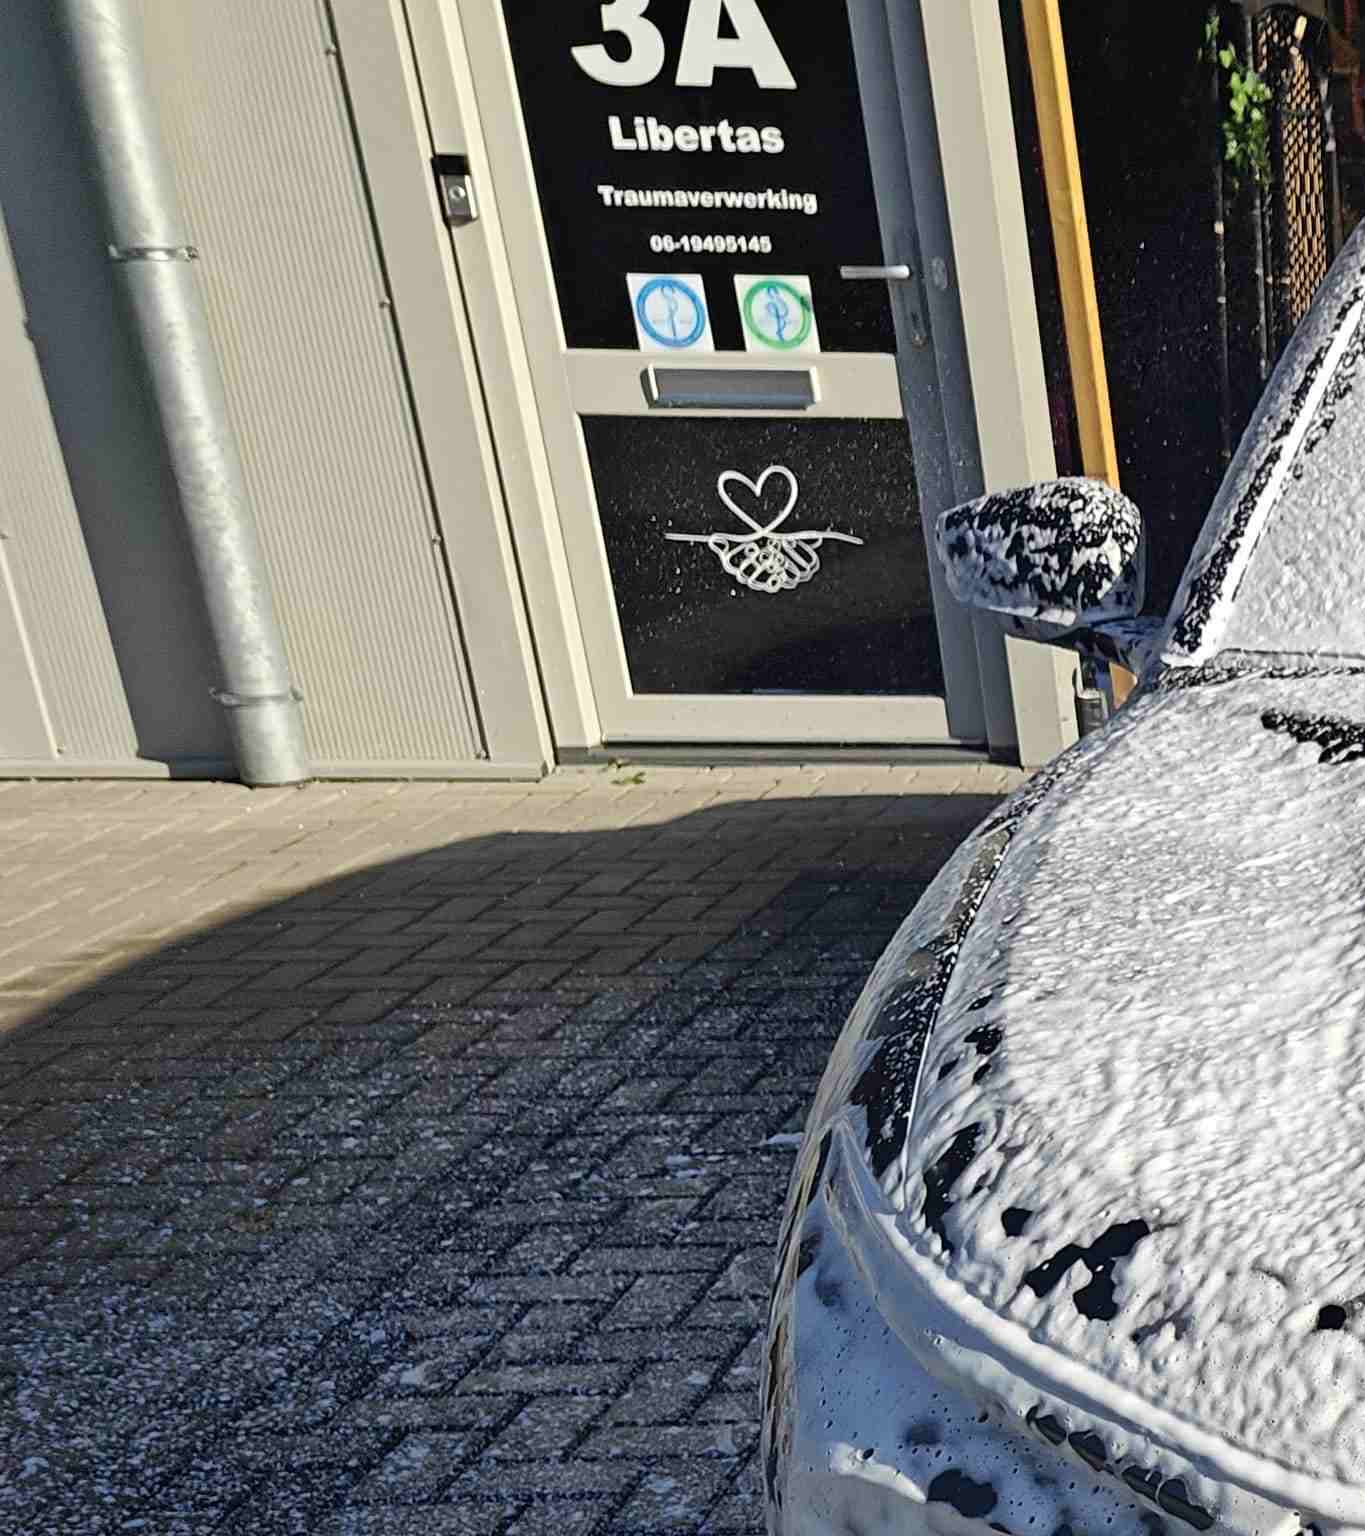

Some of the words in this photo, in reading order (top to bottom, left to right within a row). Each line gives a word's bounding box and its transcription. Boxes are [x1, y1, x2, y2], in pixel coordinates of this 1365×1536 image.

[571, 0, 798, 89] 3A
[608, 115, 785, 154] Libertas
[597, 185, 818, 215] Traumaverwerking
[650, 234, 772, 253] 06-19495145
